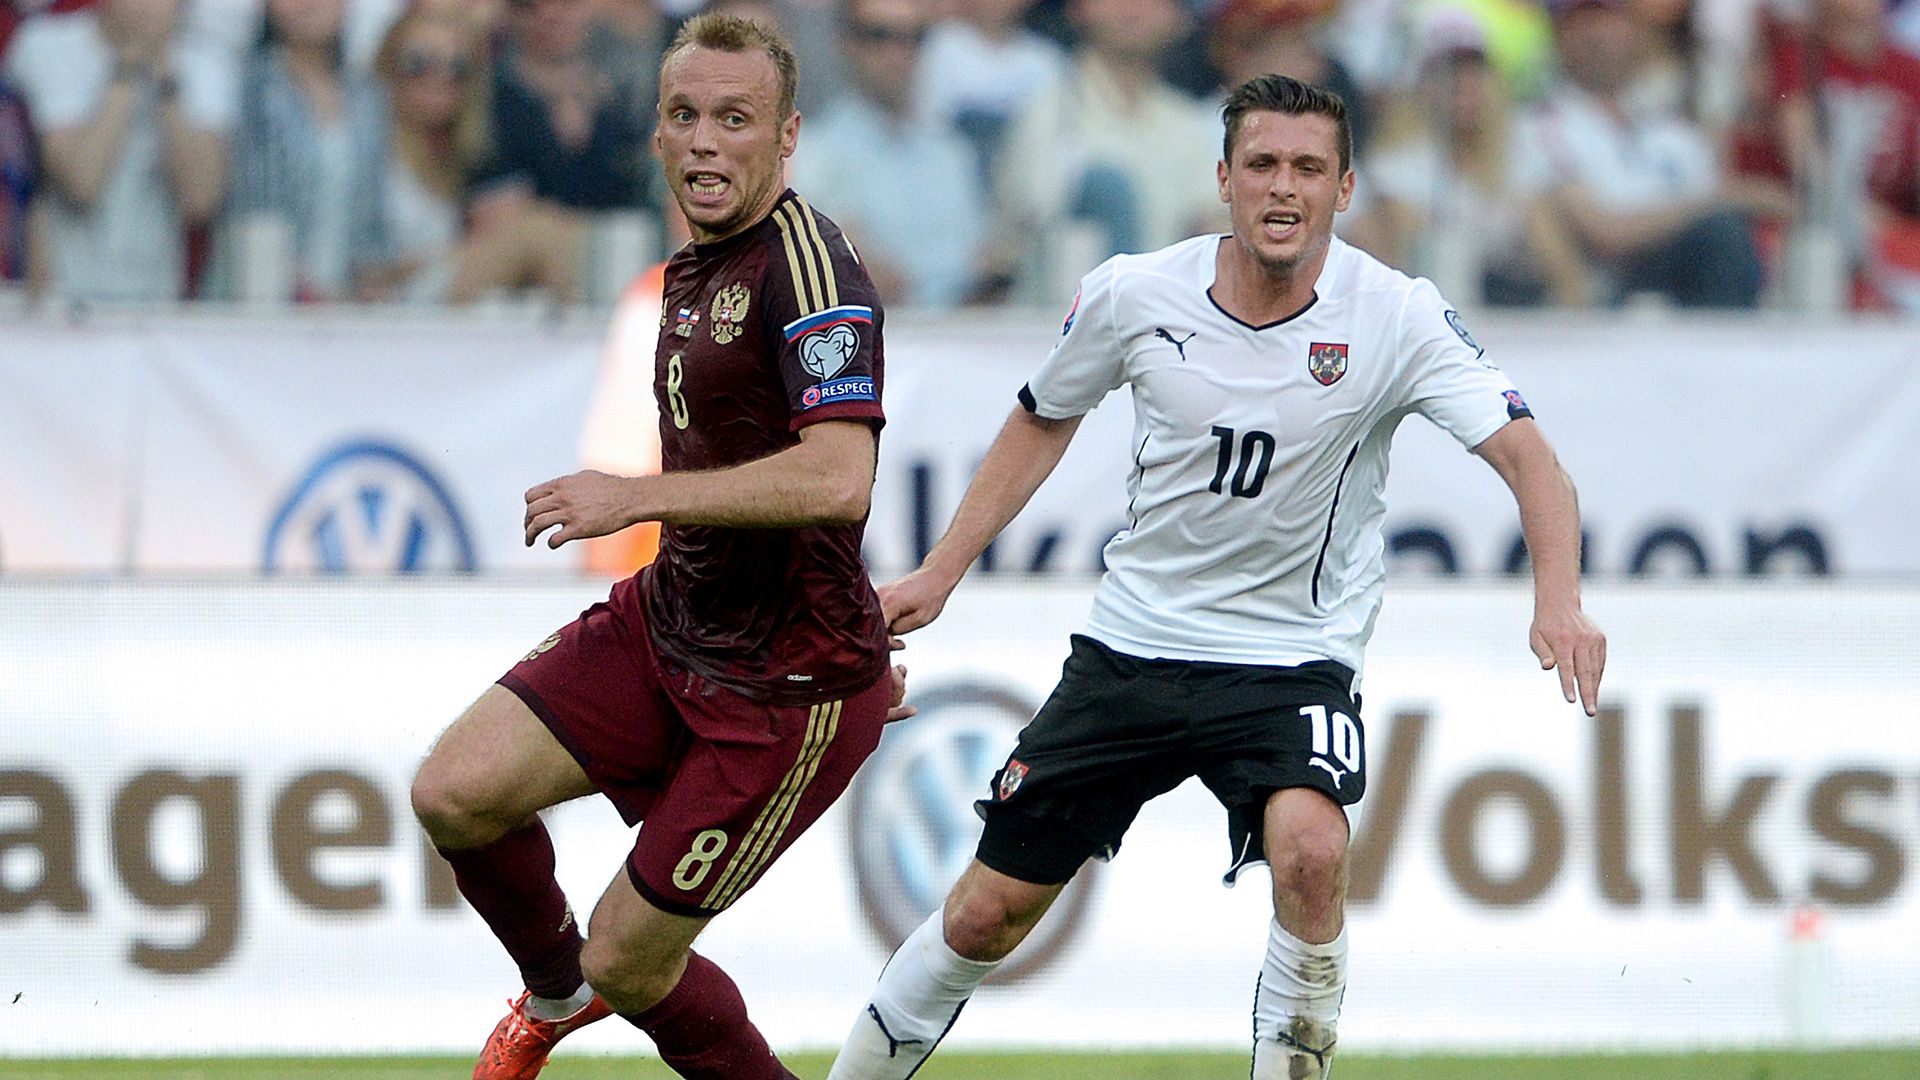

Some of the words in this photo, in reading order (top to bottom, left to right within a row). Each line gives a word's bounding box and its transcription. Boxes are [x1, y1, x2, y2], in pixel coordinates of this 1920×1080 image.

[668, 355, 689, 429] 8
[821, 382, 873, 398] RESPECT
[1208, 425, 1276, 498] 10
[1299, 704, 1360, 773] 10
[672, 828, 728, 891] 8
